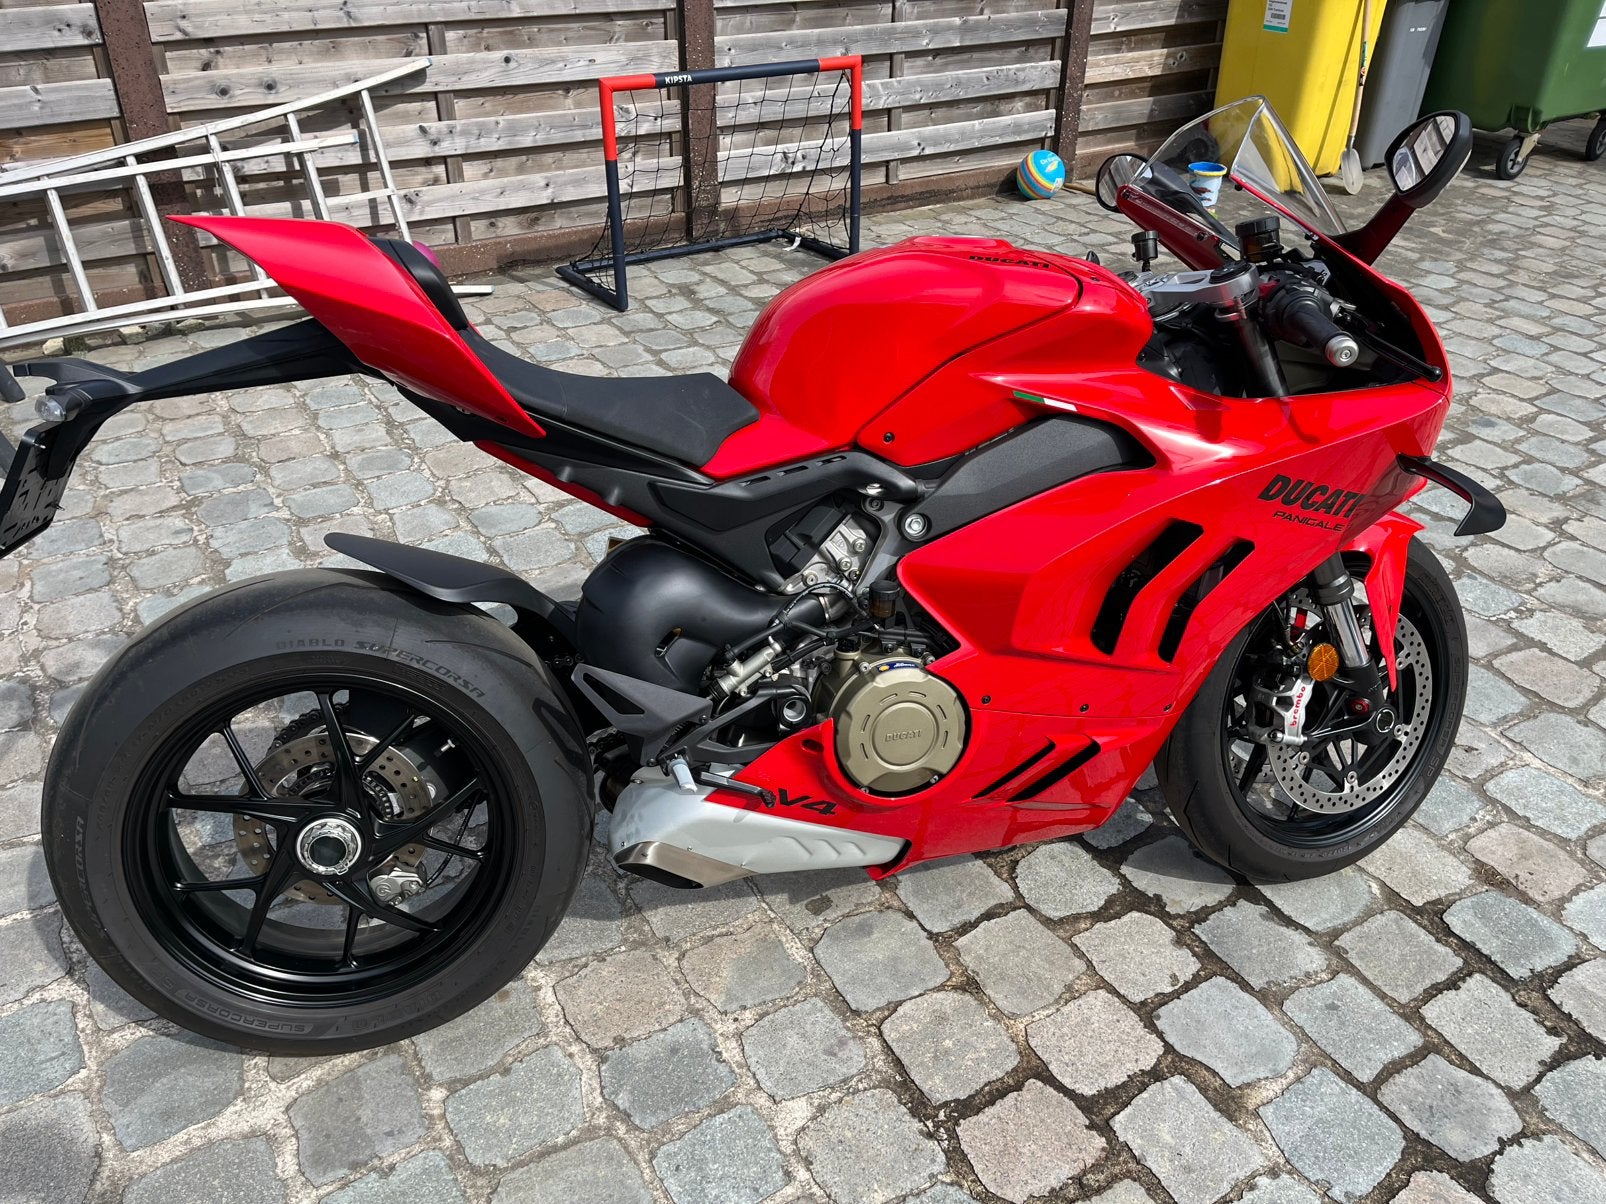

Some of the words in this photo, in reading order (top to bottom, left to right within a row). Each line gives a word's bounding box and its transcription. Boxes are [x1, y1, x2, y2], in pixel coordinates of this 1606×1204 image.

[664, 74, 693, 85] KIPSTA
[969, 255, 1050, 269] DUCATI
[1257, 473, 1370, 519] DUCATI
[1271, 510, 1346, 532] PANIGALE
[276, 638, 346, 650] DIABLO
[353, 640, 486, 699] SUPERCORSA
[1290, 686, 1306, 727] brembo
[885, 730, 922, 743] DUCATI
[778, 788, 838, 816] V4
[184, 992, 307, 1033] SUPERCORSA
